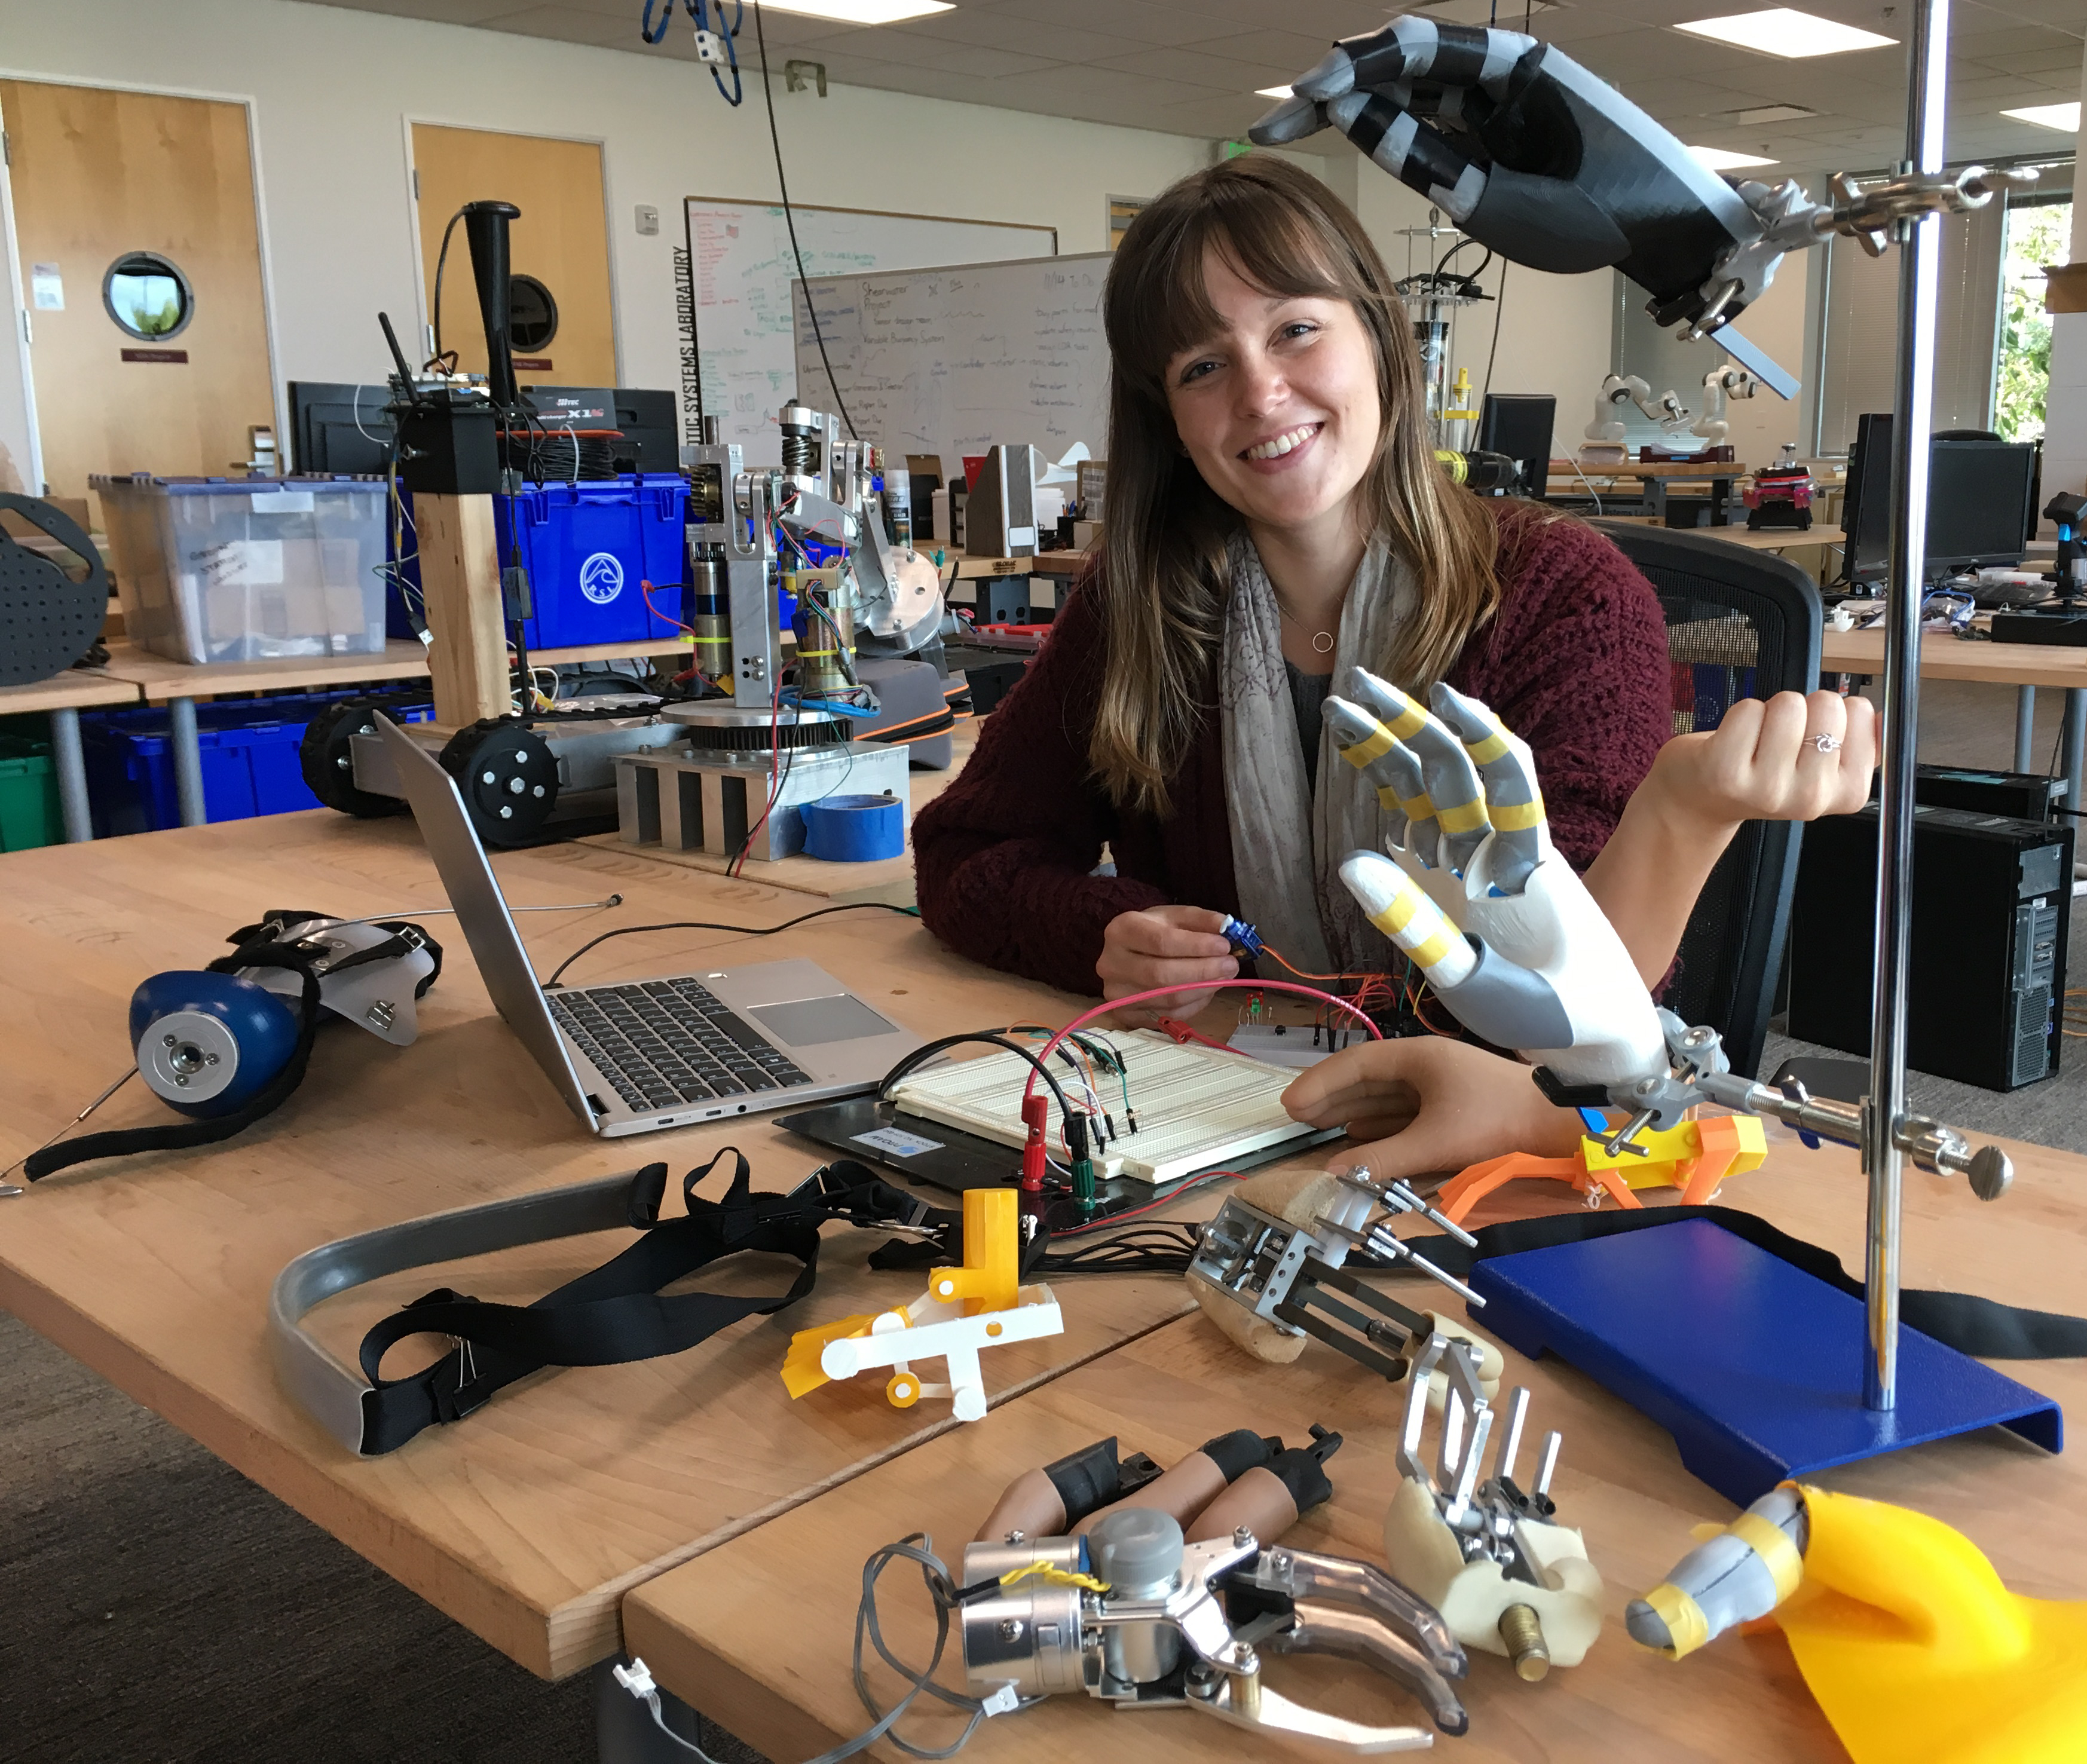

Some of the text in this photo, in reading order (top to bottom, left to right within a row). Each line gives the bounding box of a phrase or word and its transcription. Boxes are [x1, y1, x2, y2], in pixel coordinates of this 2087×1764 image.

[673, 246, 695, 341] LABORATORY
[864, 298, 891, 317] Project
[680, 347, 700, 413] SYSTEMS
[1330, 995, 1355, 1010] MODEL
